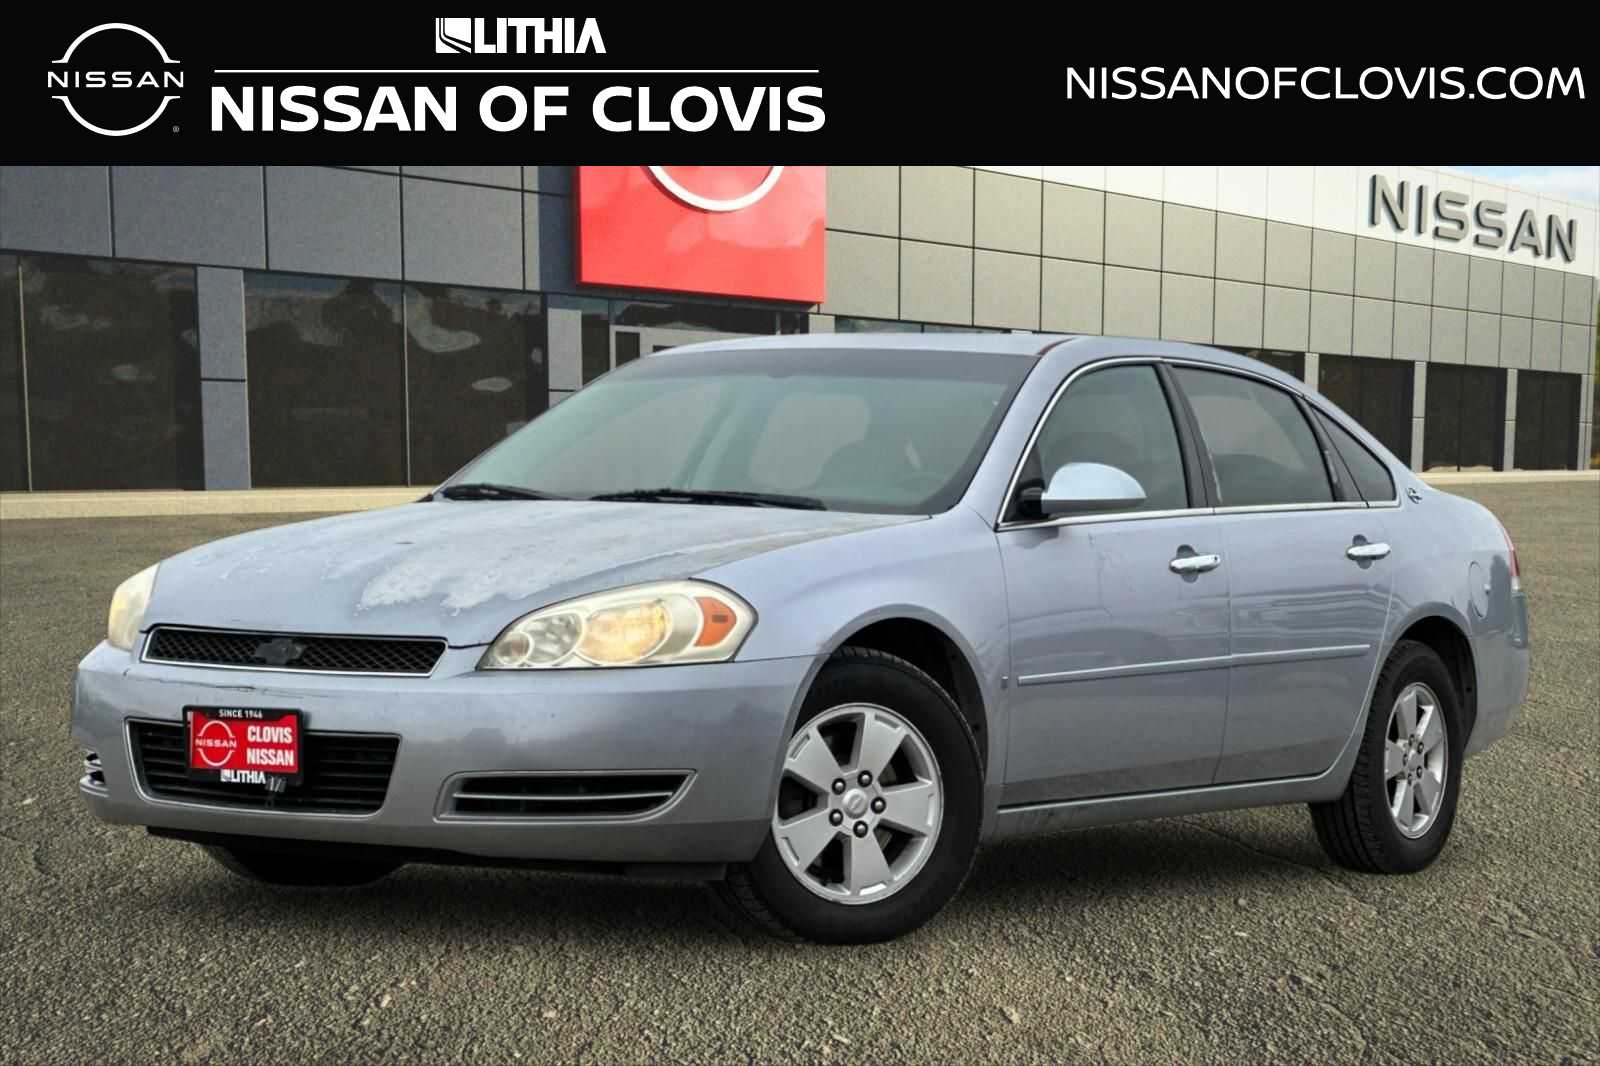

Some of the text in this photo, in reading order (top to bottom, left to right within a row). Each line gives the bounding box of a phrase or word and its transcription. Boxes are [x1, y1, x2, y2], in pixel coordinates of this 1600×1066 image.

[1369, 174, 1577, 263] NISSAN
[219, 709, 243, 718] SINCE
[247, 725, 292, 744] CLOVIS
[195, 739, 237, 748] NISSAN
[246, 748, 294, 766] NISSAN
[231, 769, 266, 784] LITHIA
